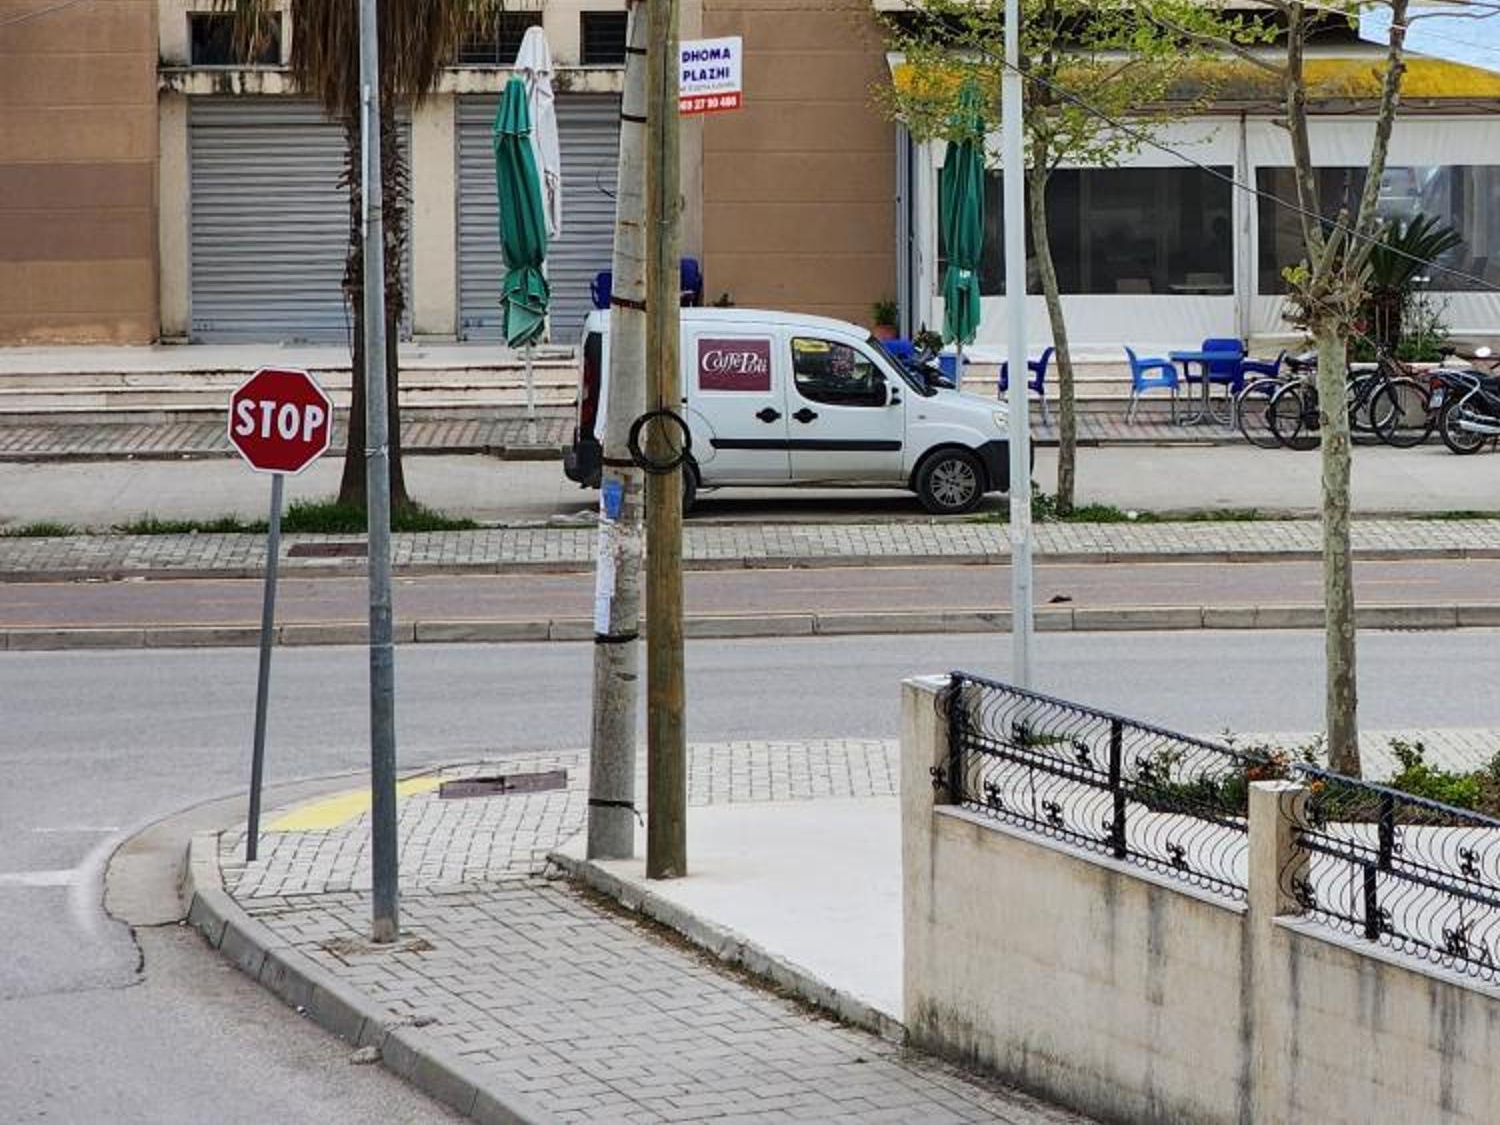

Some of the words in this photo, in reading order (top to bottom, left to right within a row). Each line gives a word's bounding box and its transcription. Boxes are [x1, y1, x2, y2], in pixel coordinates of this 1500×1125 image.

[682, 48, 731, 63] DHOMA
[683, 66, 730, 81] PLAZHI
[235, 398, 325, 442] STOP
